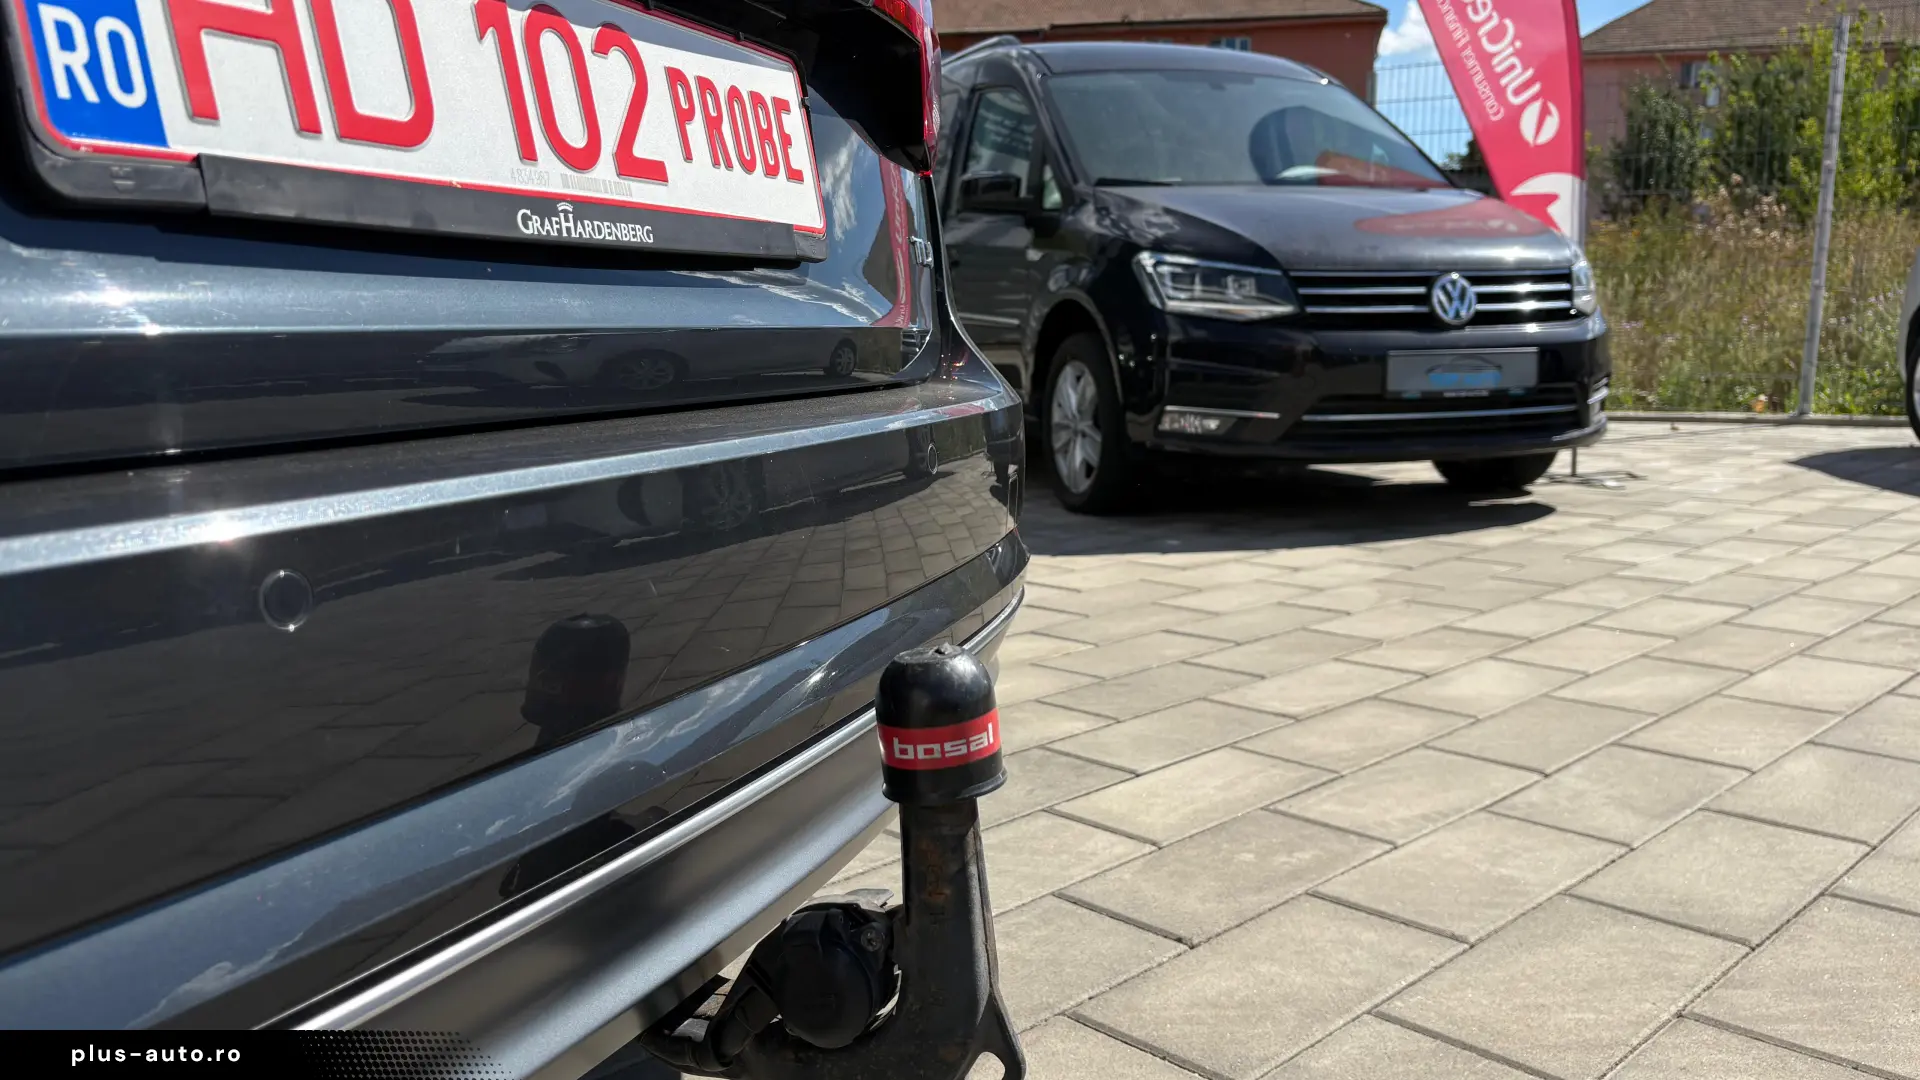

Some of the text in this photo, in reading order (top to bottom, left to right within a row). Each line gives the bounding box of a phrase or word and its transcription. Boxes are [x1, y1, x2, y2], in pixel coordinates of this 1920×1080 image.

[38, 3, 148, 109] RO
[167, 0, 804, 186] HD 102 PROBE
[893, 722, 994, 759] bosal
